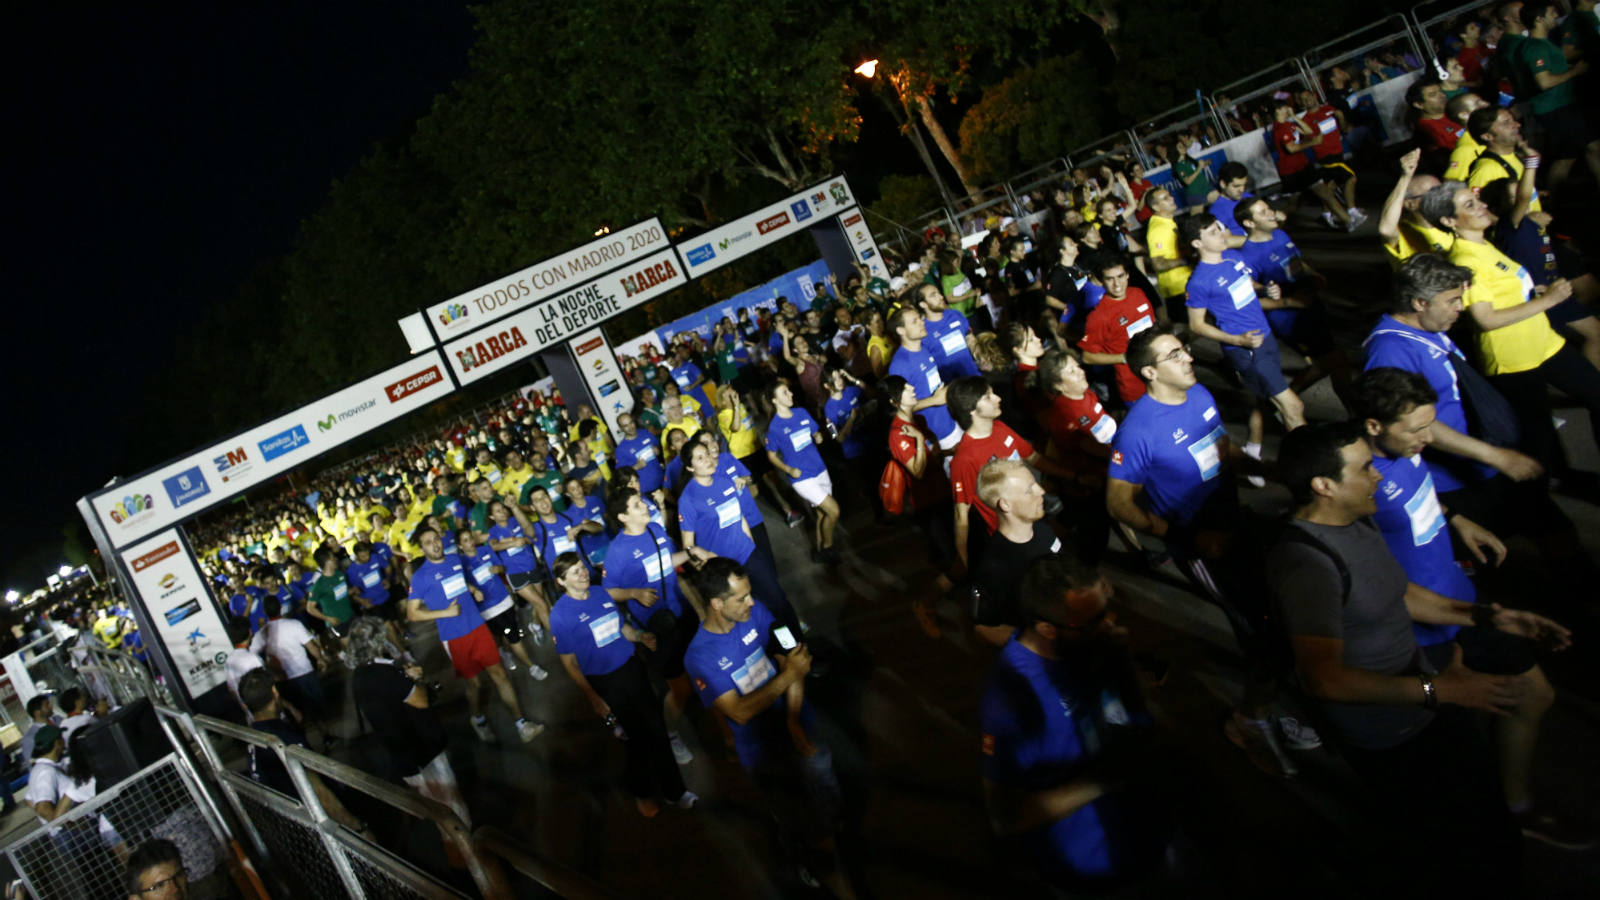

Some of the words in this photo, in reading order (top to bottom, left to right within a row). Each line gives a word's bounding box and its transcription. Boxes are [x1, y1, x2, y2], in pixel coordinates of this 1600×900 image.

[473, 280, 530, 314] TODOS
[532, 265, 567, 290] CON
[567, 240, 626, 277] MADRID
[627, 226, 661, 252] 2020
[620, 260, 678, 298] MARCA
[535, 320, 563, 344] DEL
[563, 294, 621, 332] DEPORTE
[538, 303, 559, 323] LA
[558, 284, 604, 314] NOCHE
[456, 326, 527, 372] MARCA
[405, 370, 437, 392] CEPSA
[338, 398, 377, 422] movistar
[262, 435, 292, 453] Sanitas
